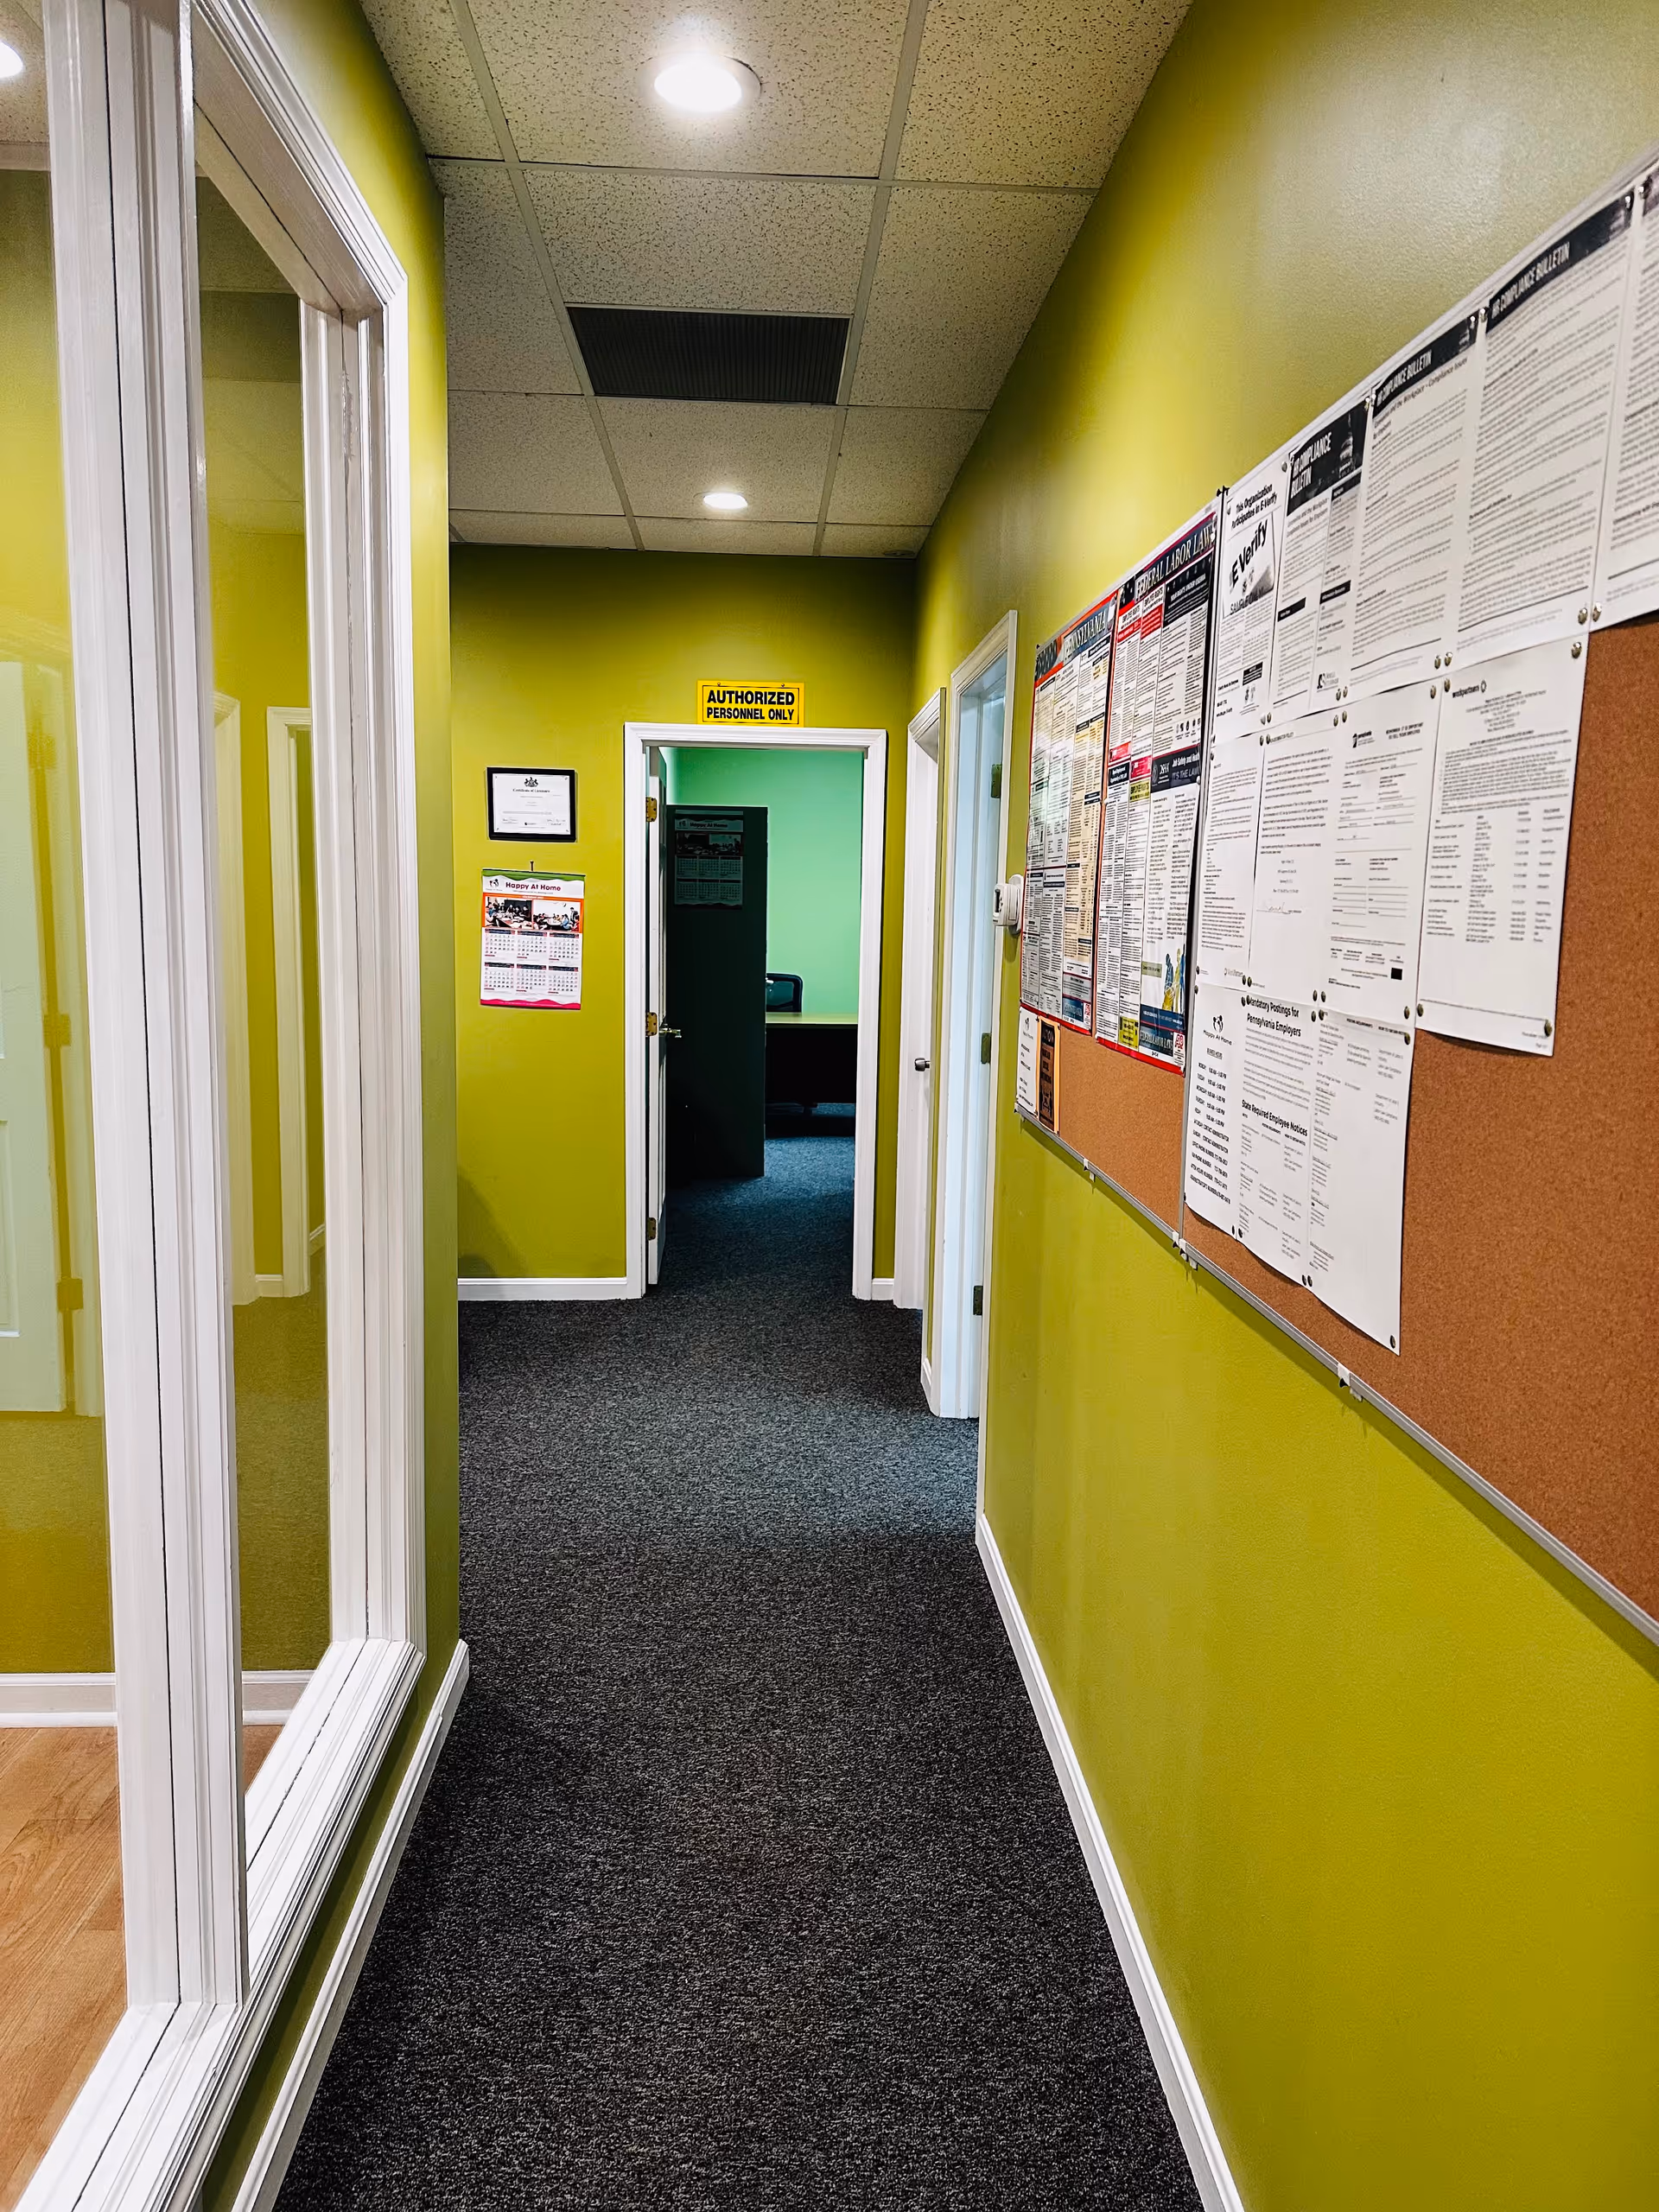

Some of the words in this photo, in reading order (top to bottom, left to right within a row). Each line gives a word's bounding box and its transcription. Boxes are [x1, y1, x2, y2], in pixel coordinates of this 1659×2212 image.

[1501, 270, 1536, 312] COMPLIANCE
[1536, 242, 1570, 282] BULLETIN
[1407, 349, 1432, 380] BULLETIN
[1300, 432, 1332, 474] COMPLIANCE
[1244, 484, 1273, 508] Organization
[1291, 465, 1312, 499] BULLETIN
[1231, 508, 1255, 530] Participates
[1260, 492, 1278, 512] E-Verify
[1136, 560, 1164, 597] FEDERAL
[1165, 539, 1192, 575] LABOR
[1064, 608, 1107, 654] PENNSYLVANIA
[707, 690, 795, 705] AUTHORIZED
[707, 707, 765, 720] PERSONNEL
[768, 709, 795, 721] ONLY
[1177, 756, 1185, 766] Safety
[1247, 1013, 1275, 1030] Pennsylvania
[1275, 1021, 1301, 1037] Employers
[1270, 1002, 1291, 1018] Postings
[1291, 1007, 1300, 1018] for
[1203, 1029, 1215, 1039] Happy
[1220, 1035, 1232, 1046] Home
[1242, 1099, 1251, 1111] State
[1251, 1104, 1269, 1119] Required
[1269, 1112, 1290, 1129] Employee
[1290, 1122, 1308, 1137] Notices
